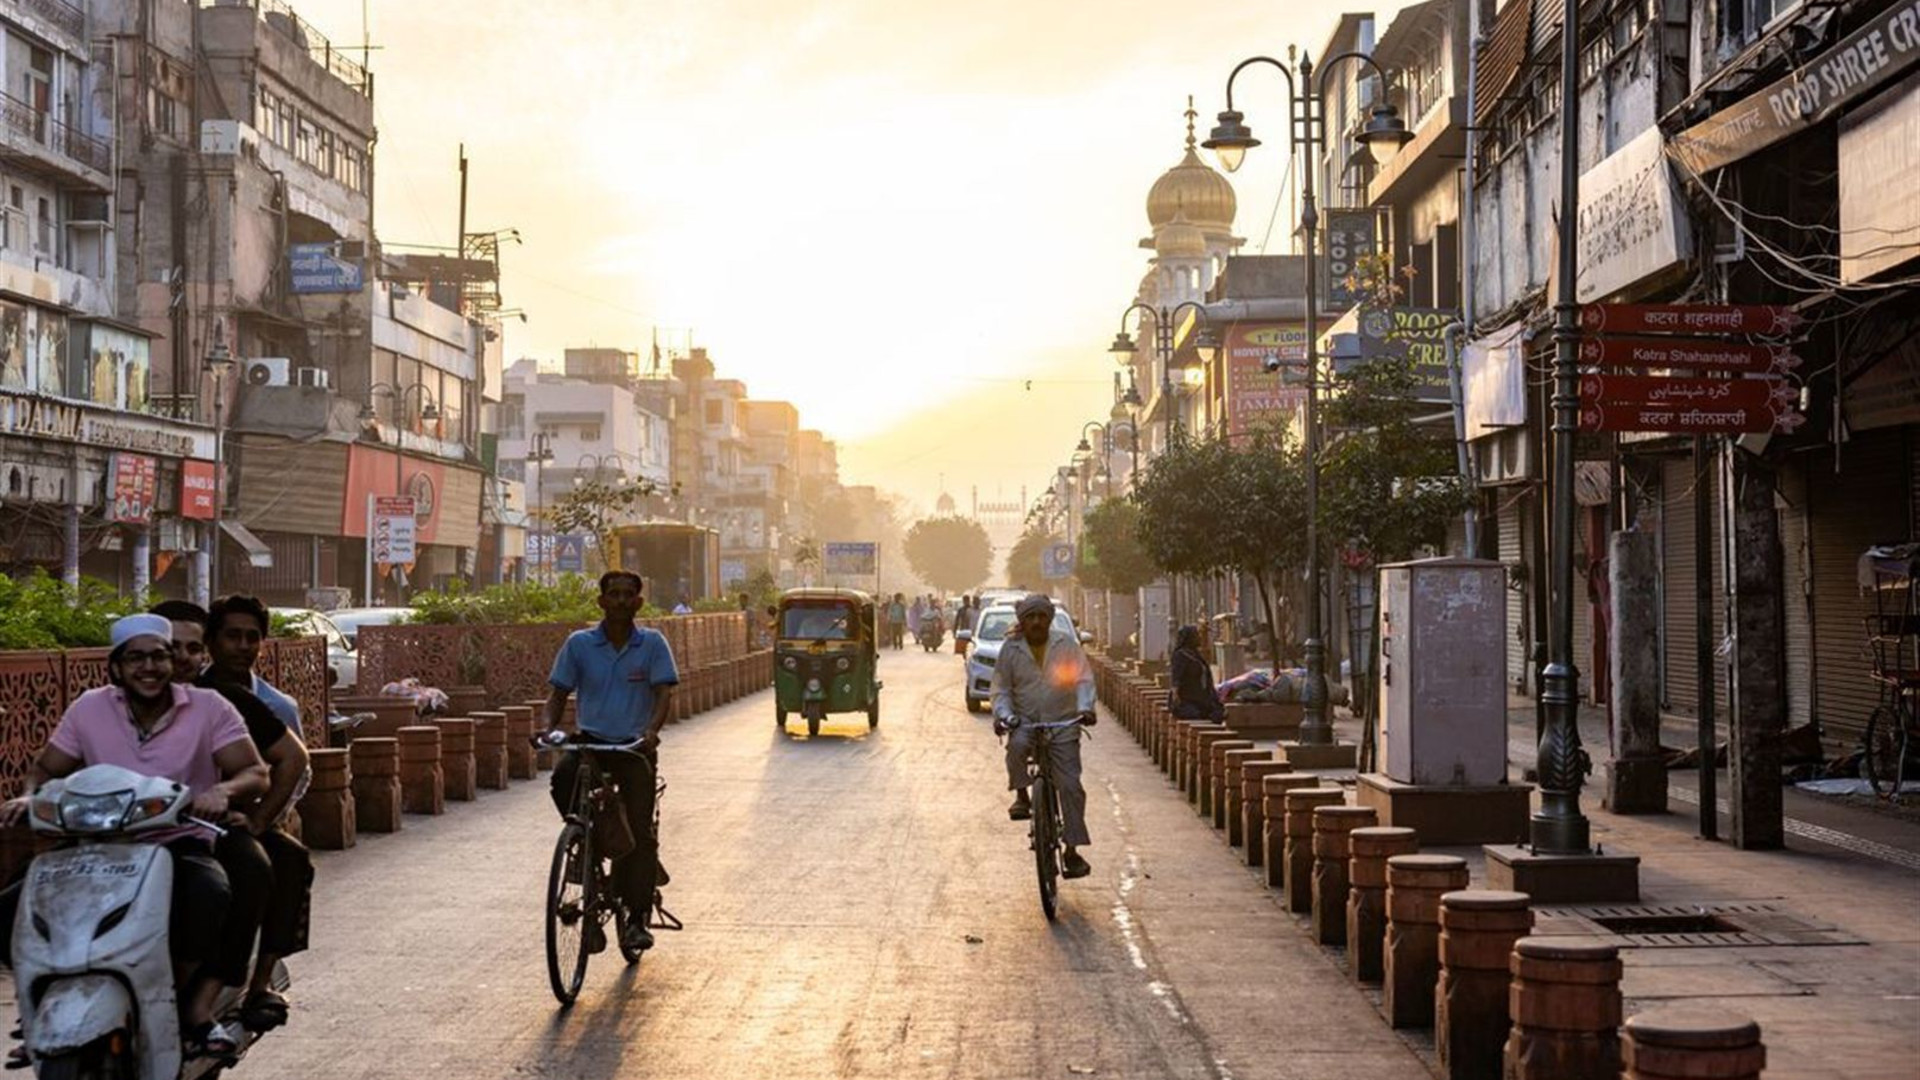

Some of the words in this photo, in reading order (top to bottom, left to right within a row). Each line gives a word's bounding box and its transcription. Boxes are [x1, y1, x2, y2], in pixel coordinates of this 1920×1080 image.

[1769, 74, 1822, 126] ROOP
[1820, 30, 1890, 97] SHREE
[1887, 1, 1920, 52] CR
[1644, 312, 1678, 325] कटरा
[1633, 348, 1666, 360] Katra
[1670, 349, 1750, 364] Shahanshahi
[16, 398, 85, 442] DALMIA
